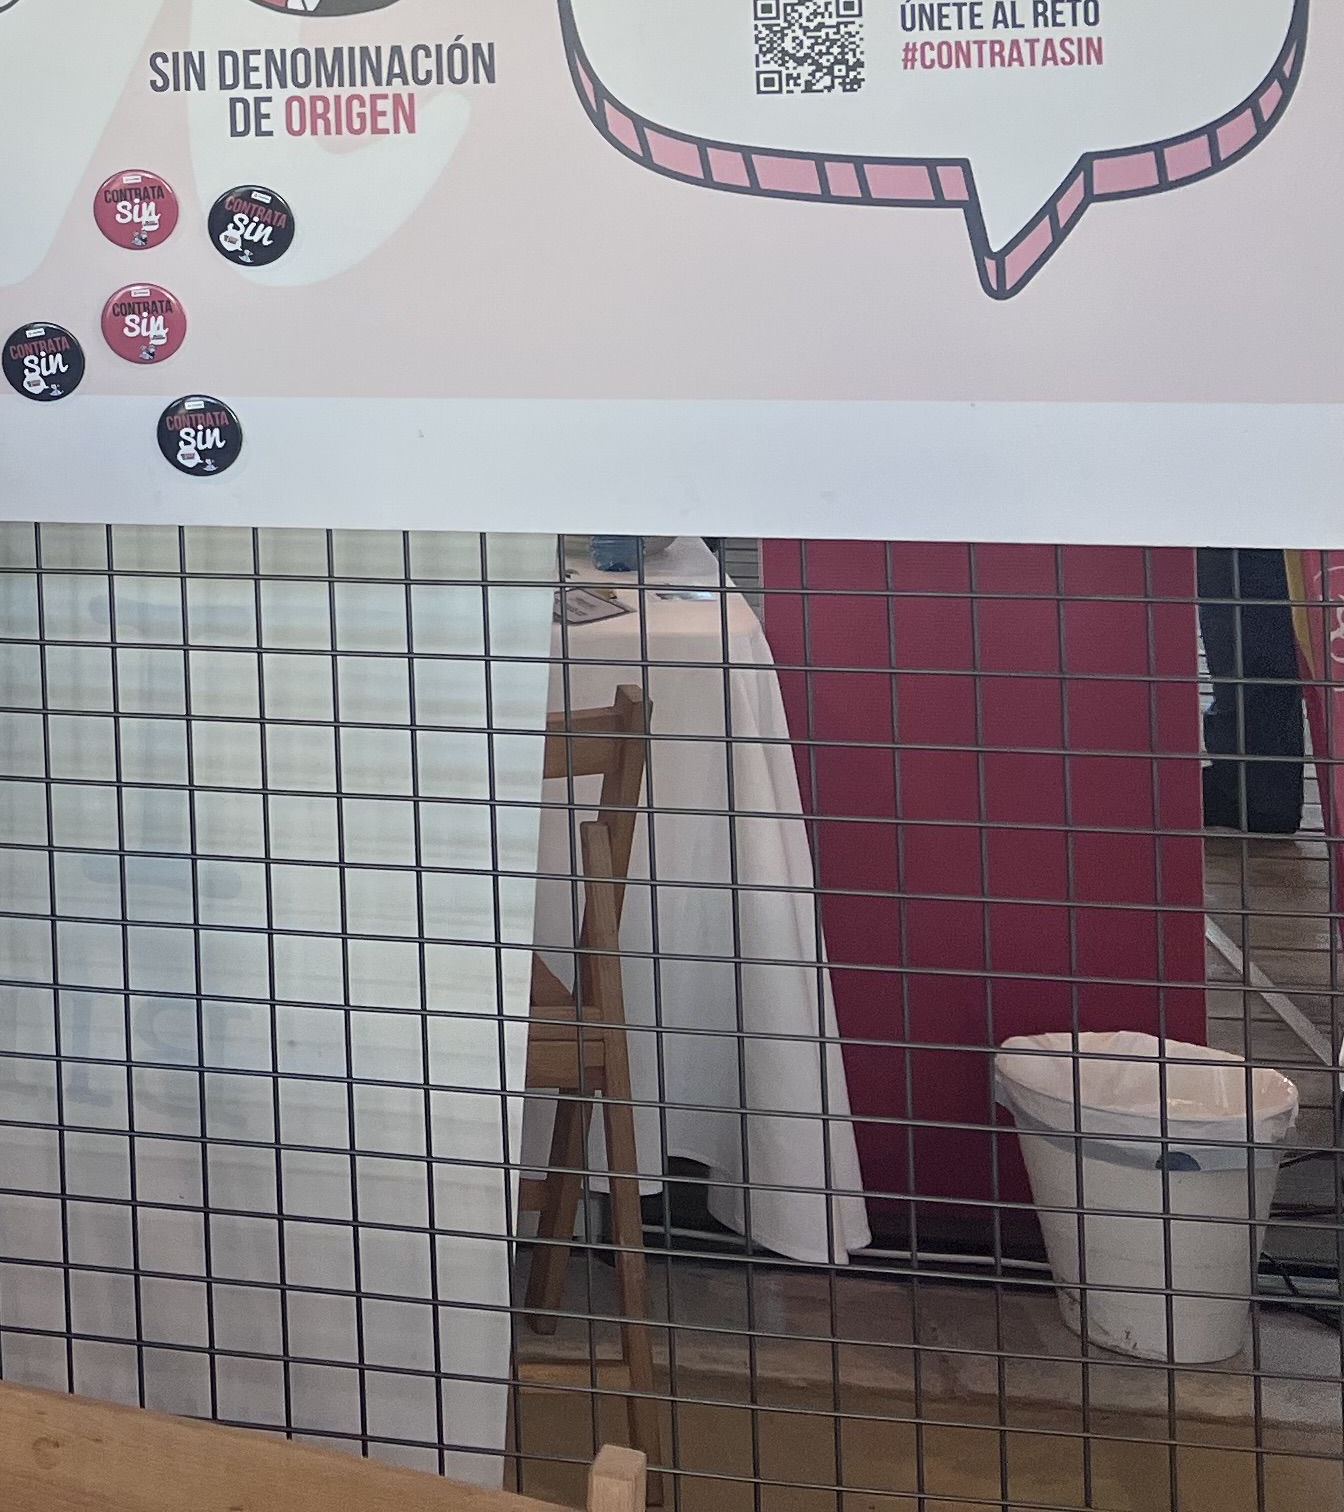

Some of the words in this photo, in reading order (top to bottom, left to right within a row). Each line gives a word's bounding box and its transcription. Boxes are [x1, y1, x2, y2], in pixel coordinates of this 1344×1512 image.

[992, 0, 1025, 29] AL
[149, 51, 206, 93] SIN
[218, 34, 496, 91] DENOMINACIÓN
[901, 37, 1103, 70] #CONTRATASIN
[229, 96, 274, 138] DE
[285, 93, 416, 137] ORIGEN
[104, 186, 165, 203] CONTRATA
[225, 194, 287, 228] CONTRATA
[227, 213, 274, 246] Sin
[112, 299, 173, 317] CONTRATA
[9, 336, 70, 360] CONTRATA
[23, 351, 68, 378] Sin
[166, 411, 229, 431] CONTRATA
[178, 425, 226, 452] Sin
